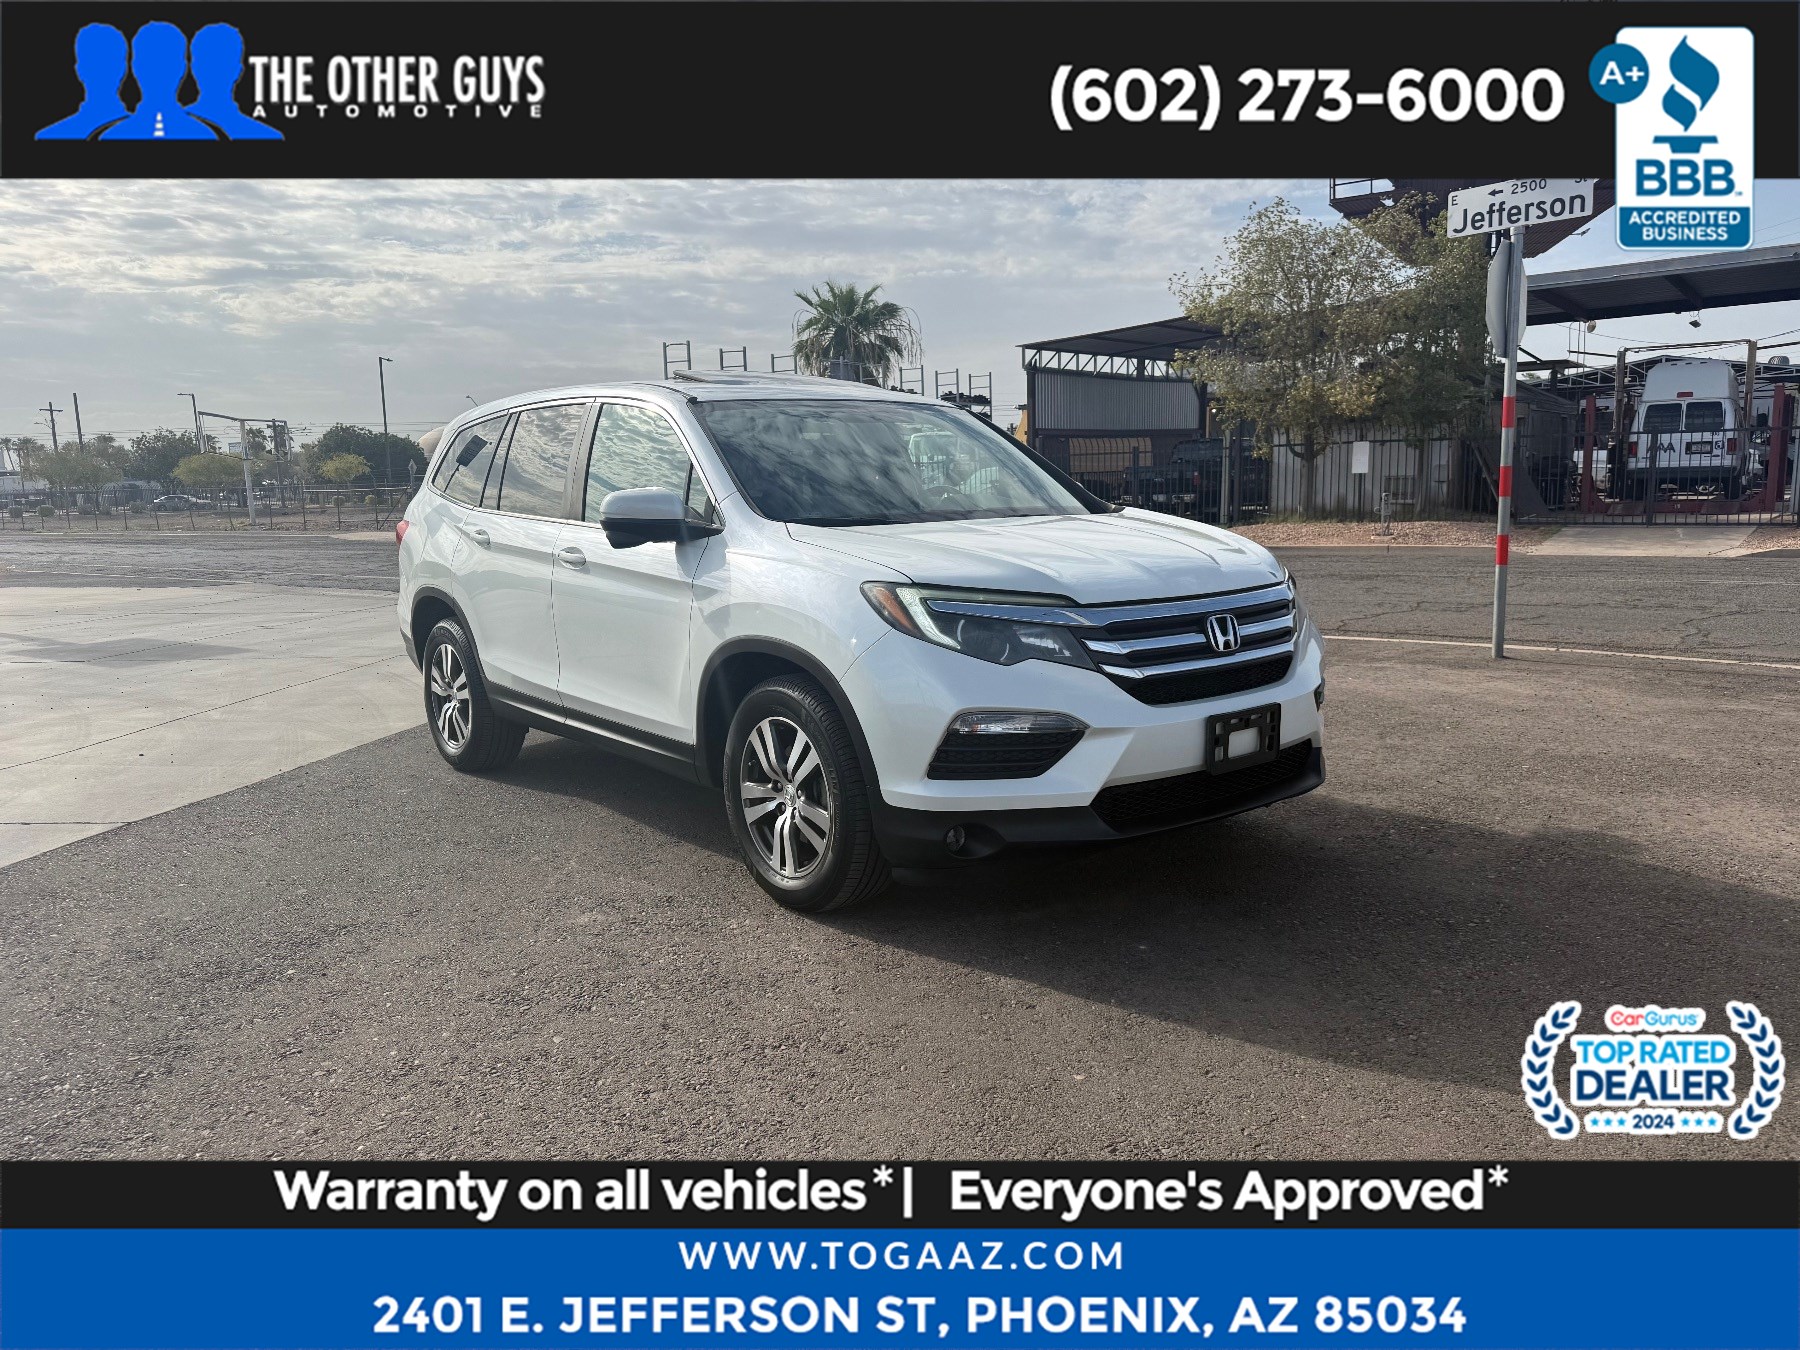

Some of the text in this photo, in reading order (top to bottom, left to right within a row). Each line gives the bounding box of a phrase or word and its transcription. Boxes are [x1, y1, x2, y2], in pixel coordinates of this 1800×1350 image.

[1510, 178, 1548, 195] 2500
[1451, 194, 1459, 207] E
[1452, 193, 1587, 234] Jefferson
